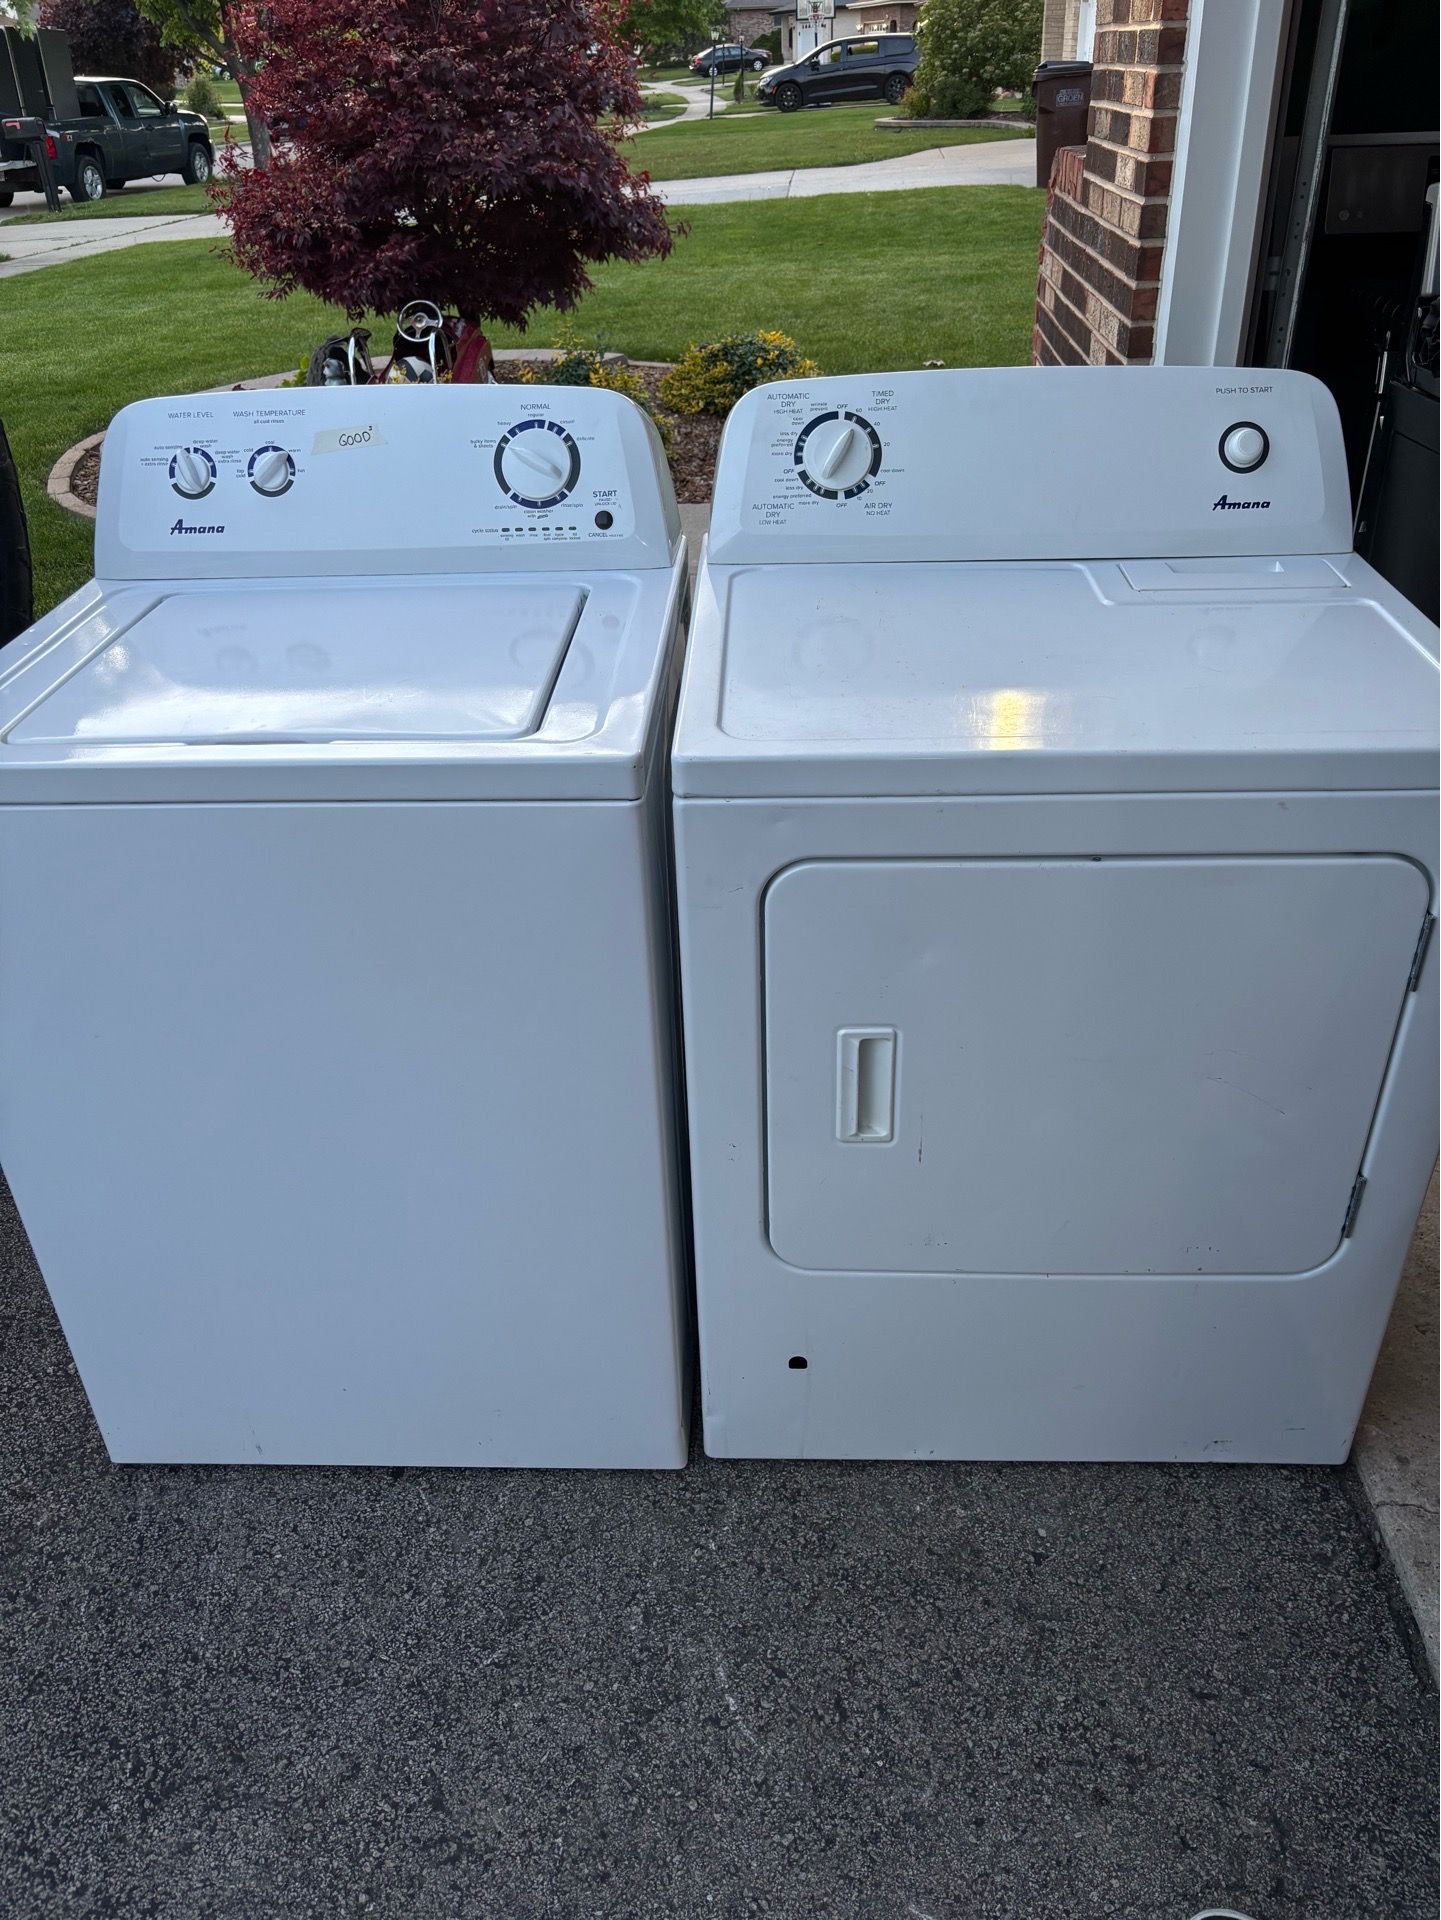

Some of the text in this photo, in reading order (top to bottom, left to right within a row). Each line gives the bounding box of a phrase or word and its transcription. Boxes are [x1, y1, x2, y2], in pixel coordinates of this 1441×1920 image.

[256, 409, 306, 417] TEMPERATURE
[338, 431, 370, 446] GOOD
[592, 490, 618, 498] START
[1212, 494, 1270, 511] Amana
[170, 518, 225, 536] Amana
